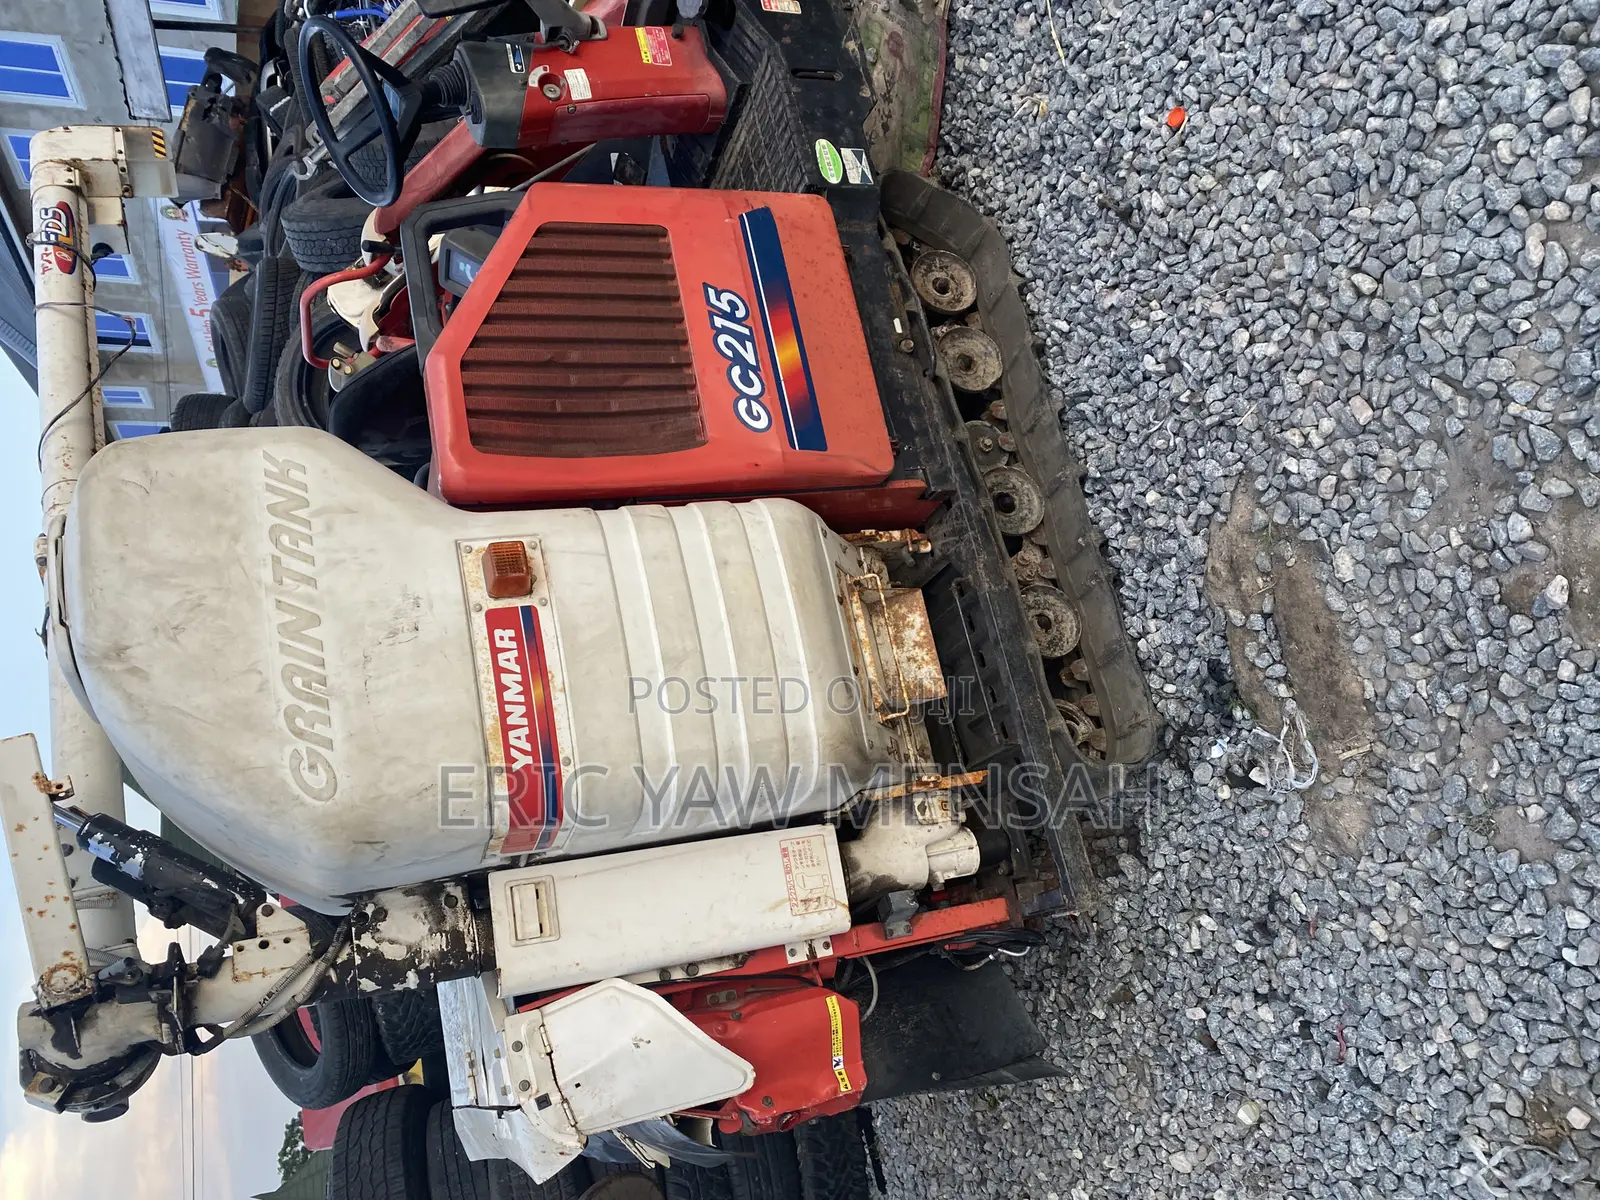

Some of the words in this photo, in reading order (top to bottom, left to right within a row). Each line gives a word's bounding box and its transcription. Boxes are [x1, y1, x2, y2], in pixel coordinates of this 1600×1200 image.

[175, 229, 200, 280] Warranty
[189, 307, 212, 318] 5
[192, 281, 209, 306] Years
[704, 284, 771, 432] GC215
[262, 450, 318, 590] TANK
[275, 598, 338, 802] GRAIN
[494, 628, 533, 772] YANMAR
